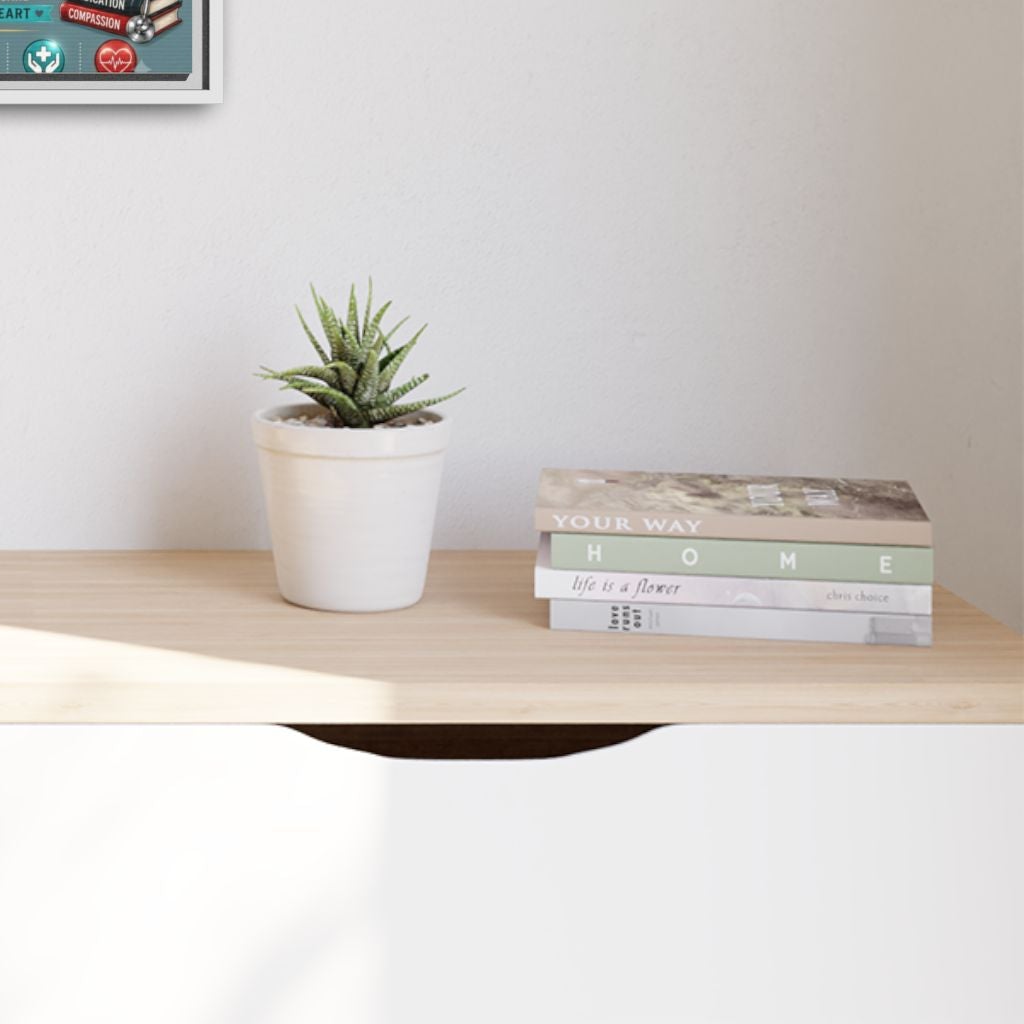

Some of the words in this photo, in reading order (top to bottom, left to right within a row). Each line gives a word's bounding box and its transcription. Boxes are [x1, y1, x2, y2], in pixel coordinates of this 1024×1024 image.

[68, 8, 121, 30] COMPASSION
[553, 515, 632, 531] YOUR
[642, 517, 703, 533] WAY
[587, 544, 893, 574] HOME
[572, 576, 596, 596] life
[602, 579, 614, 592] is
[620, 584, 629, 592] a
[632, 578, 682, 599] flower
[826, 589, 852, 601] chris
[608, 606, 619, 629] love
[622, 605, 630, 631] runs
[632, 609, 641, 628] out
